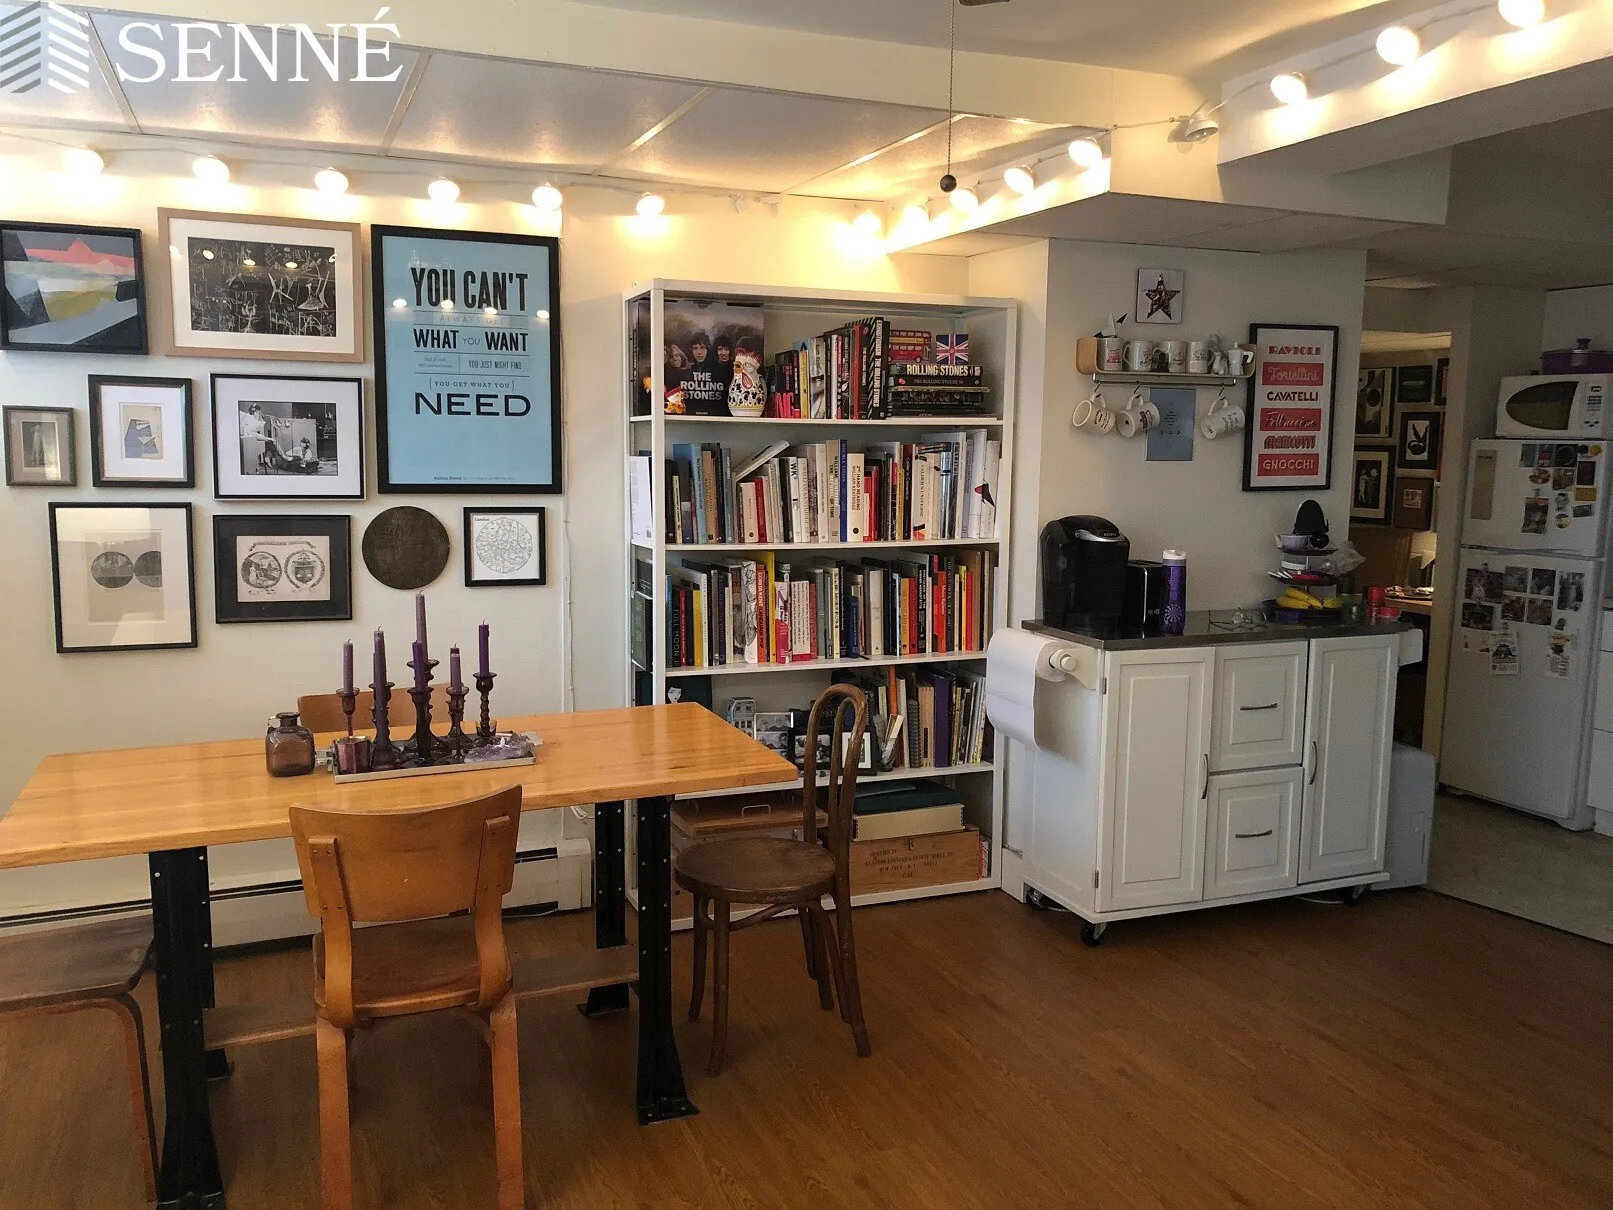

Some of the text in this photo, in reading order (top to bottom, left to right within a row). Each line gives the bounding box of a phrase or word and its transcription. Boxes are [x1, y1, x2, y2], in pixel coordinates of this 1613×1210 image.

[411, 267, 529, 312] YOU CAN'T
[413, 328, 529, 352] WHAT YOU WANT
[1268, 346, 1321, 356] RAVIOLI
[468, 360, 522, 370] YOU JUST MIGHT FIND
[906, 364, 968, 376] ROLLING STONES
[692, 372, 712, 382] THE
[680, 380, 724, 391] ROLLING
[684, 390, 722, 400] STONES
[1266, 391, 1318, 402] CAVATELLI
[414, 392, 532, 417] NEED
[1263, 460, 1314, 470] GNOCCHI
